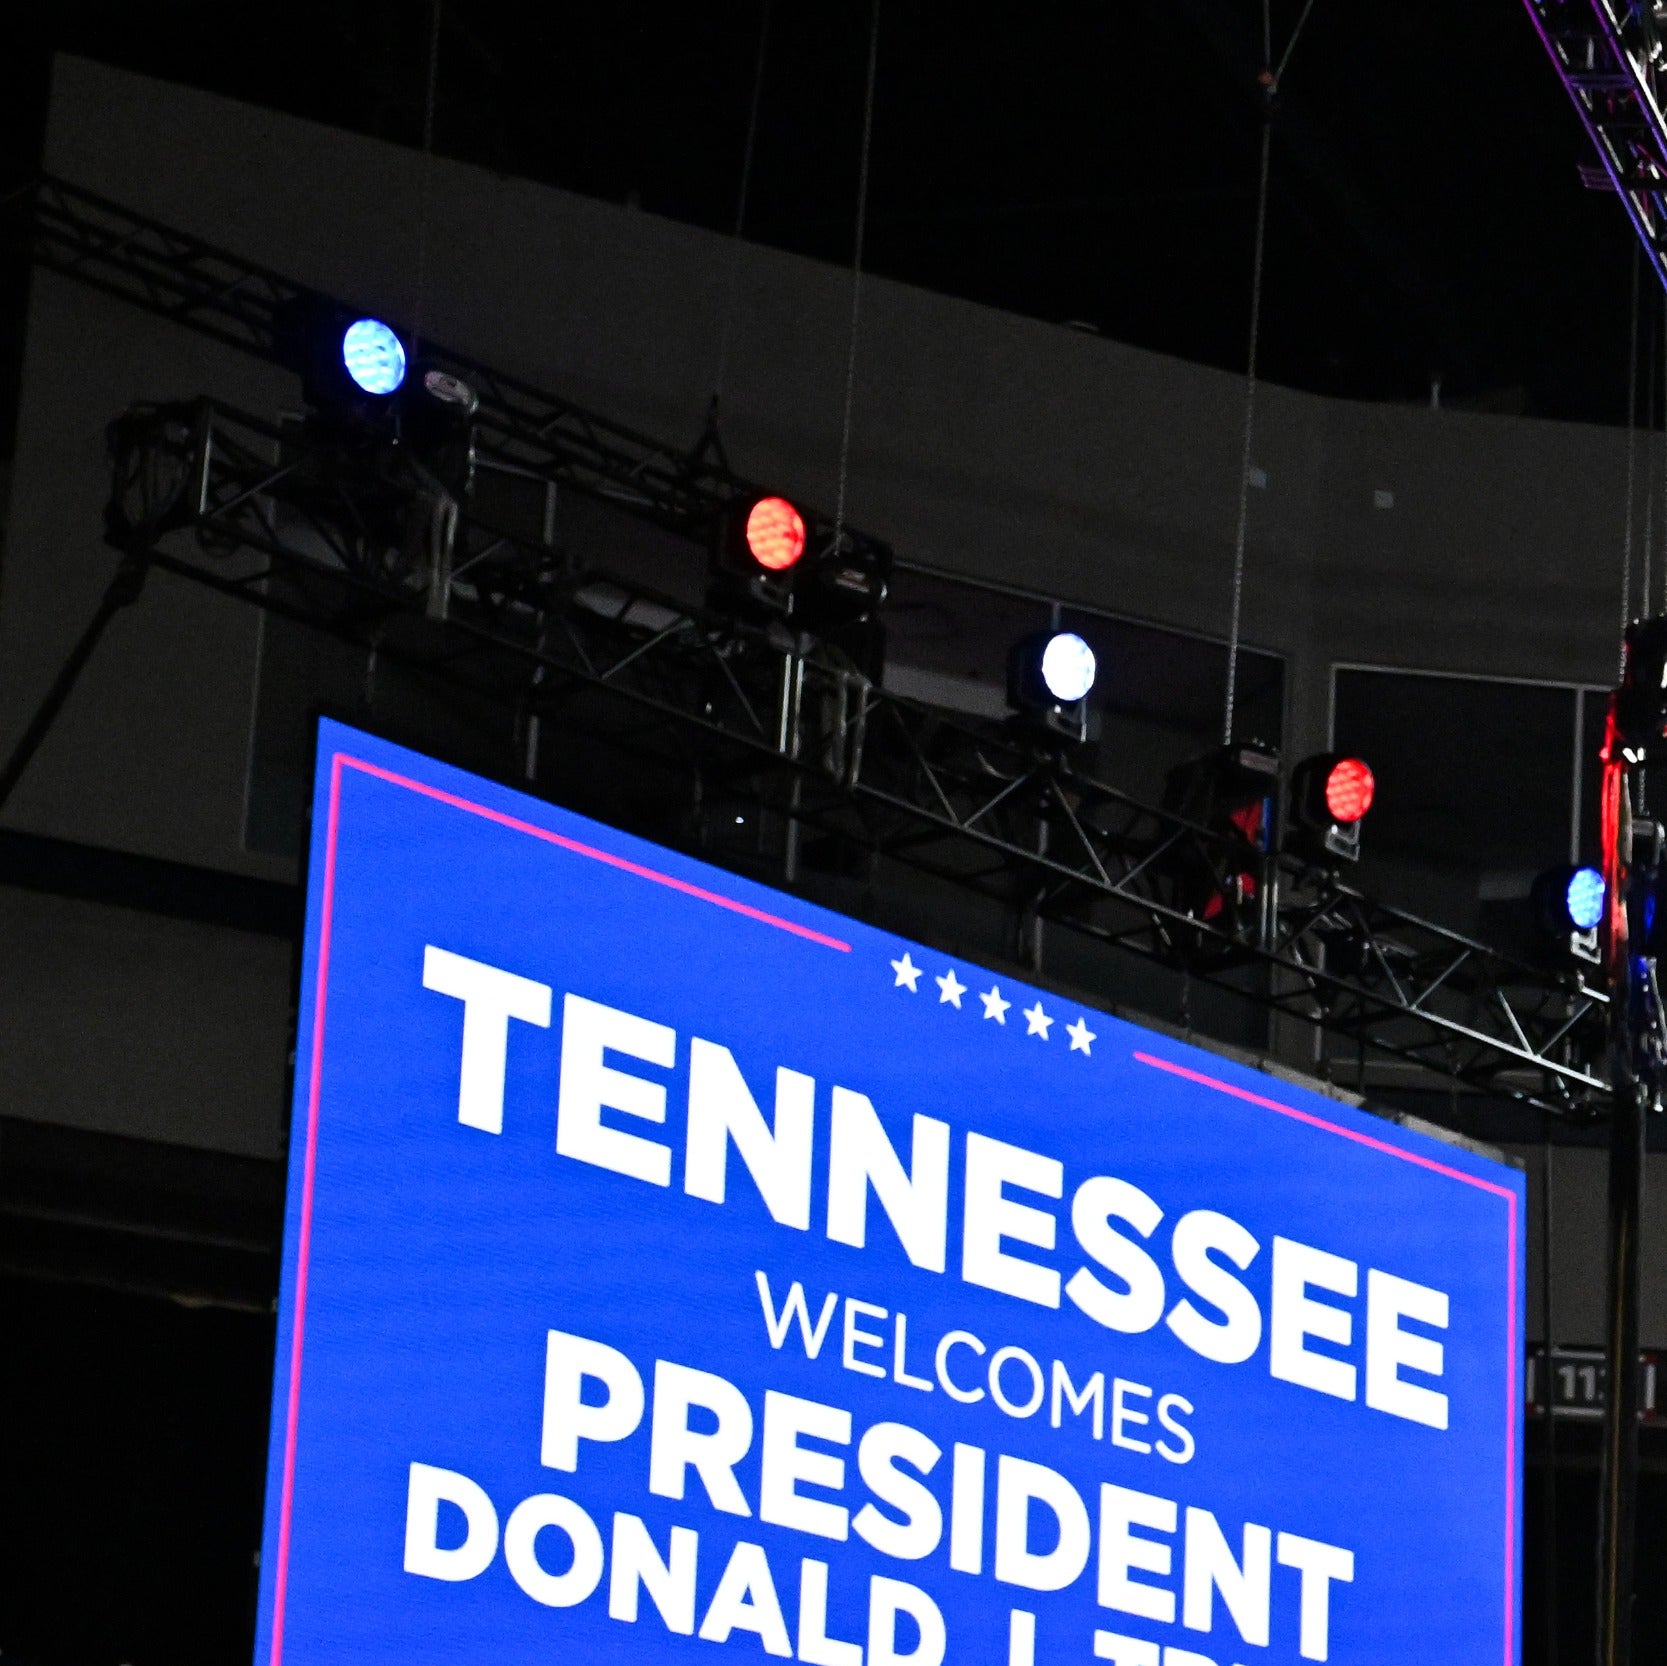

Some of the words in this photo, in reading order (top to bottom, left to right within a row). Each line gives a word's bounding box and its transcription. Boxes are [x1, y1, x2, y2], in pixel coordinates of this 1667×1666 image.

[422, 945, 1449, 1431] TENNESSEE
[540, 1330, 1354, 1662] PRESIDENT
[756, 1271, 1195, 1464] WELCOMES
[1558, 1364, 1606, 1400] 11
